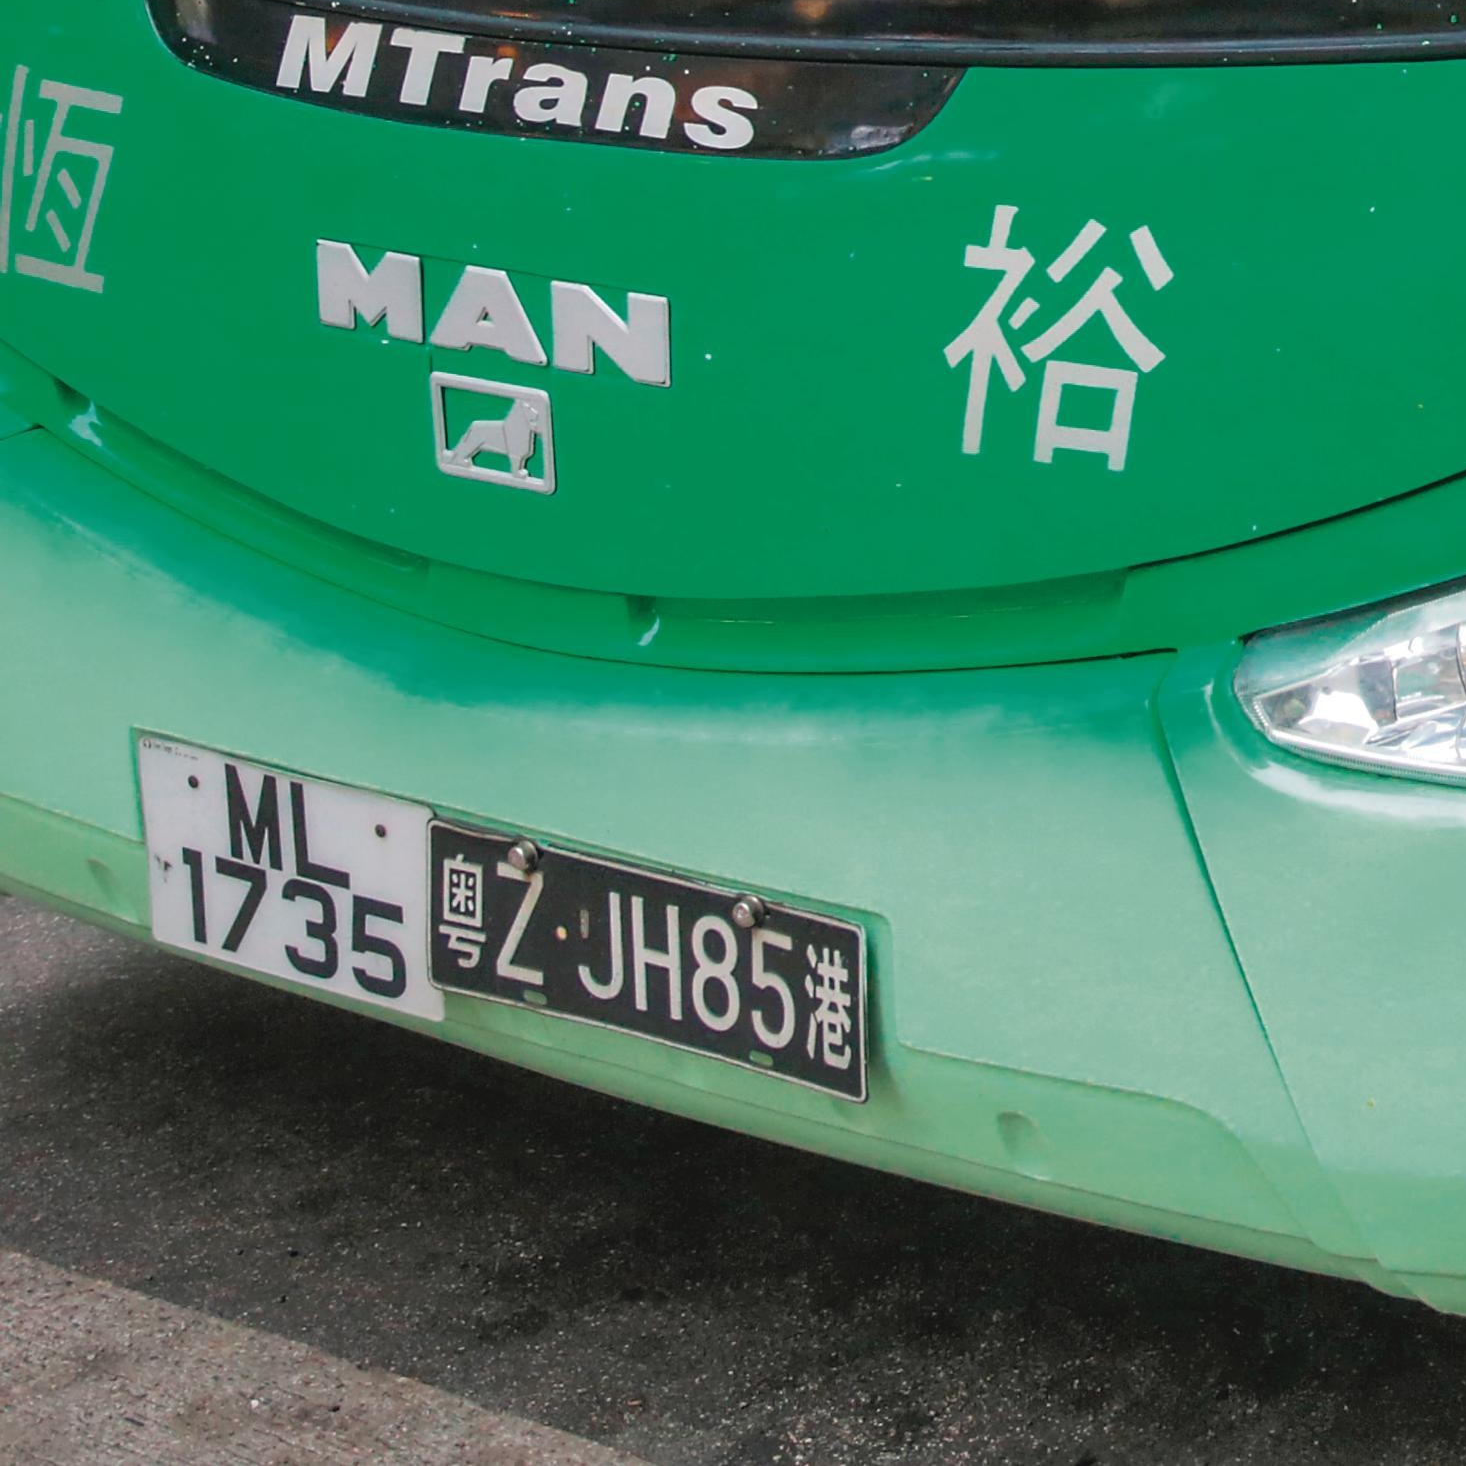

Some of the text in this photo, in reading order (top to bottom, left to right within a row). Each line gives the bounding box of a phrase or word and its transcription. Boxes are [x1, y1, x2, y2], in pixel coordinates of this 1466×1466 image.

[275, 15, 760, 152] MTrans
[314, 238, 672, 389] MAN
[223, 762, 352, 891] ML
[181, 846, 408, 1001] 1735
